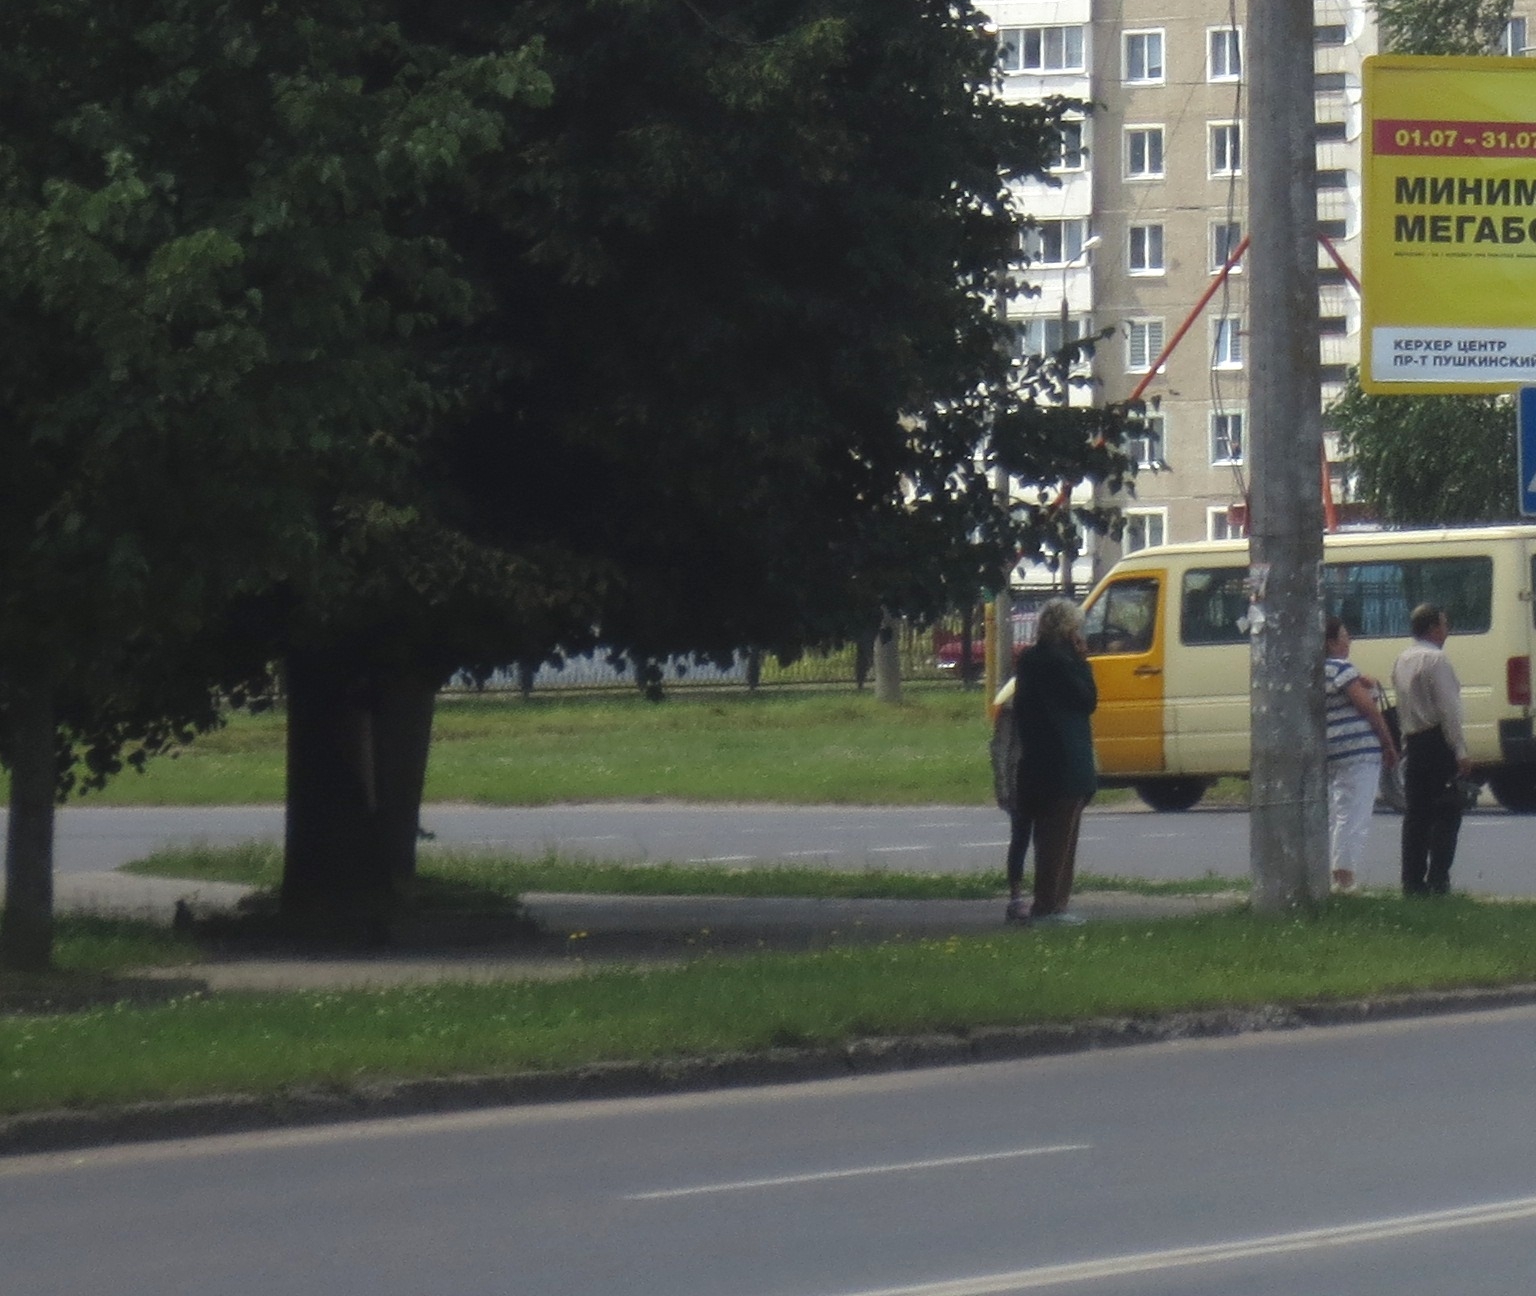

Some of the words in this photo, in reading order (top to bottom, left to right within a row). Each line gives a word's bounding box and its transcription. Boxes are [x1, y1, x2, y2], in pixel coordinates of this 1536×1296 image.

[1395, 130, 1458, 147] 01.07
[1394, 339, 1453, 351] КЕРХЕР
[1458, 341, 1507, 353] ЦЕНТР
[1394, 355, 1428, 366] ПР-Т
